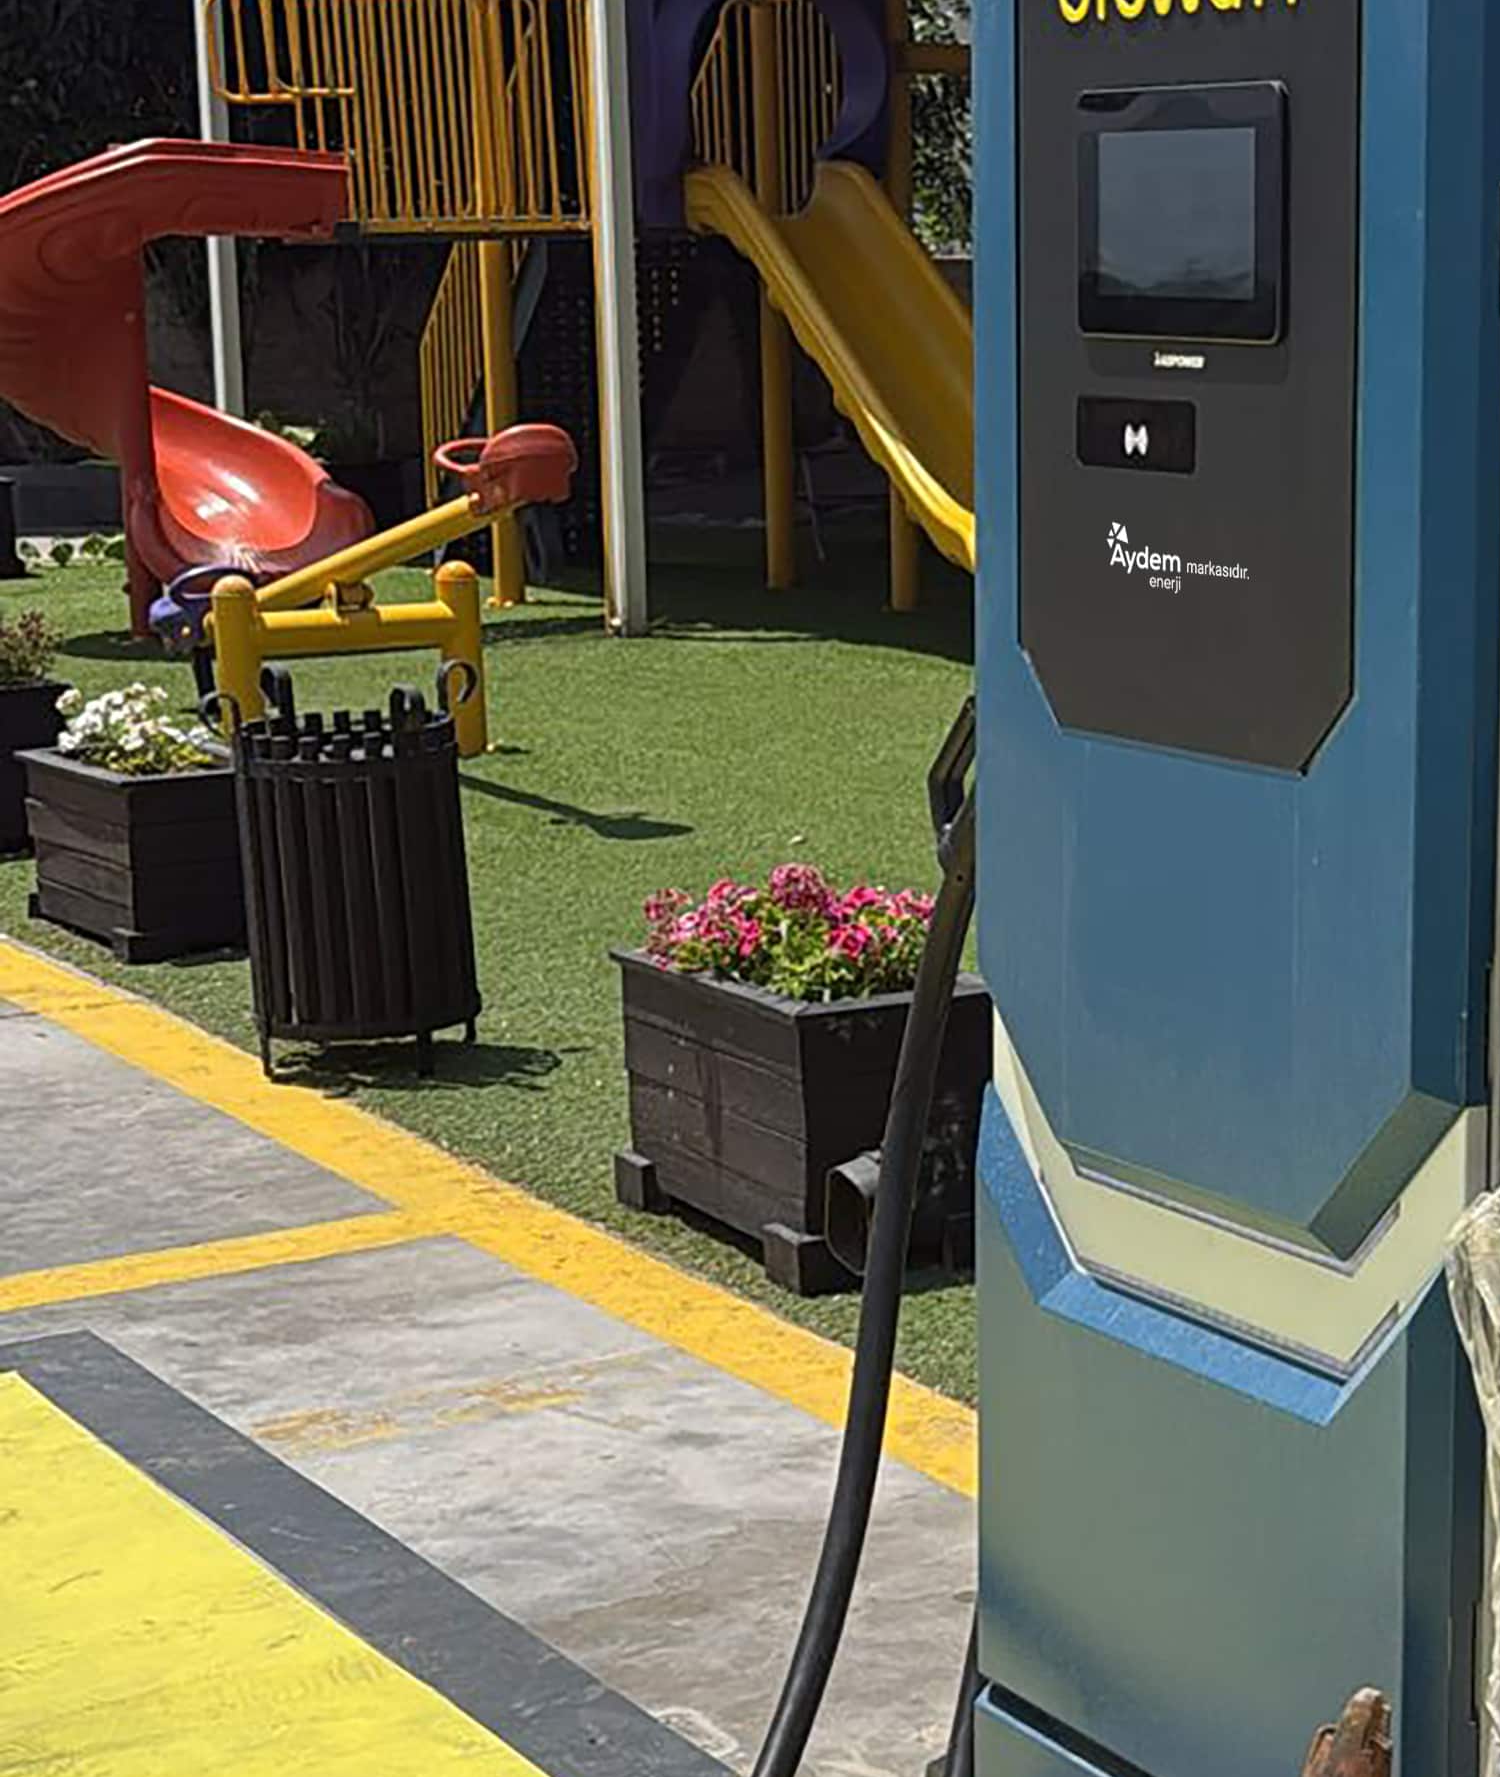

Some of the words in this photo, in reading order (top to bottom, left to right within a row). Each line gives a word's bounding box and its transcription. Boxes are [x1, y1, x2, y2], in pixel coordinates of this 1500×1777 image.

[1109, 543, 1181, 574] Aydem
[1186, 561, 1250, 580] markasıdır.
[1149, 576, 1182, 594] enerji
